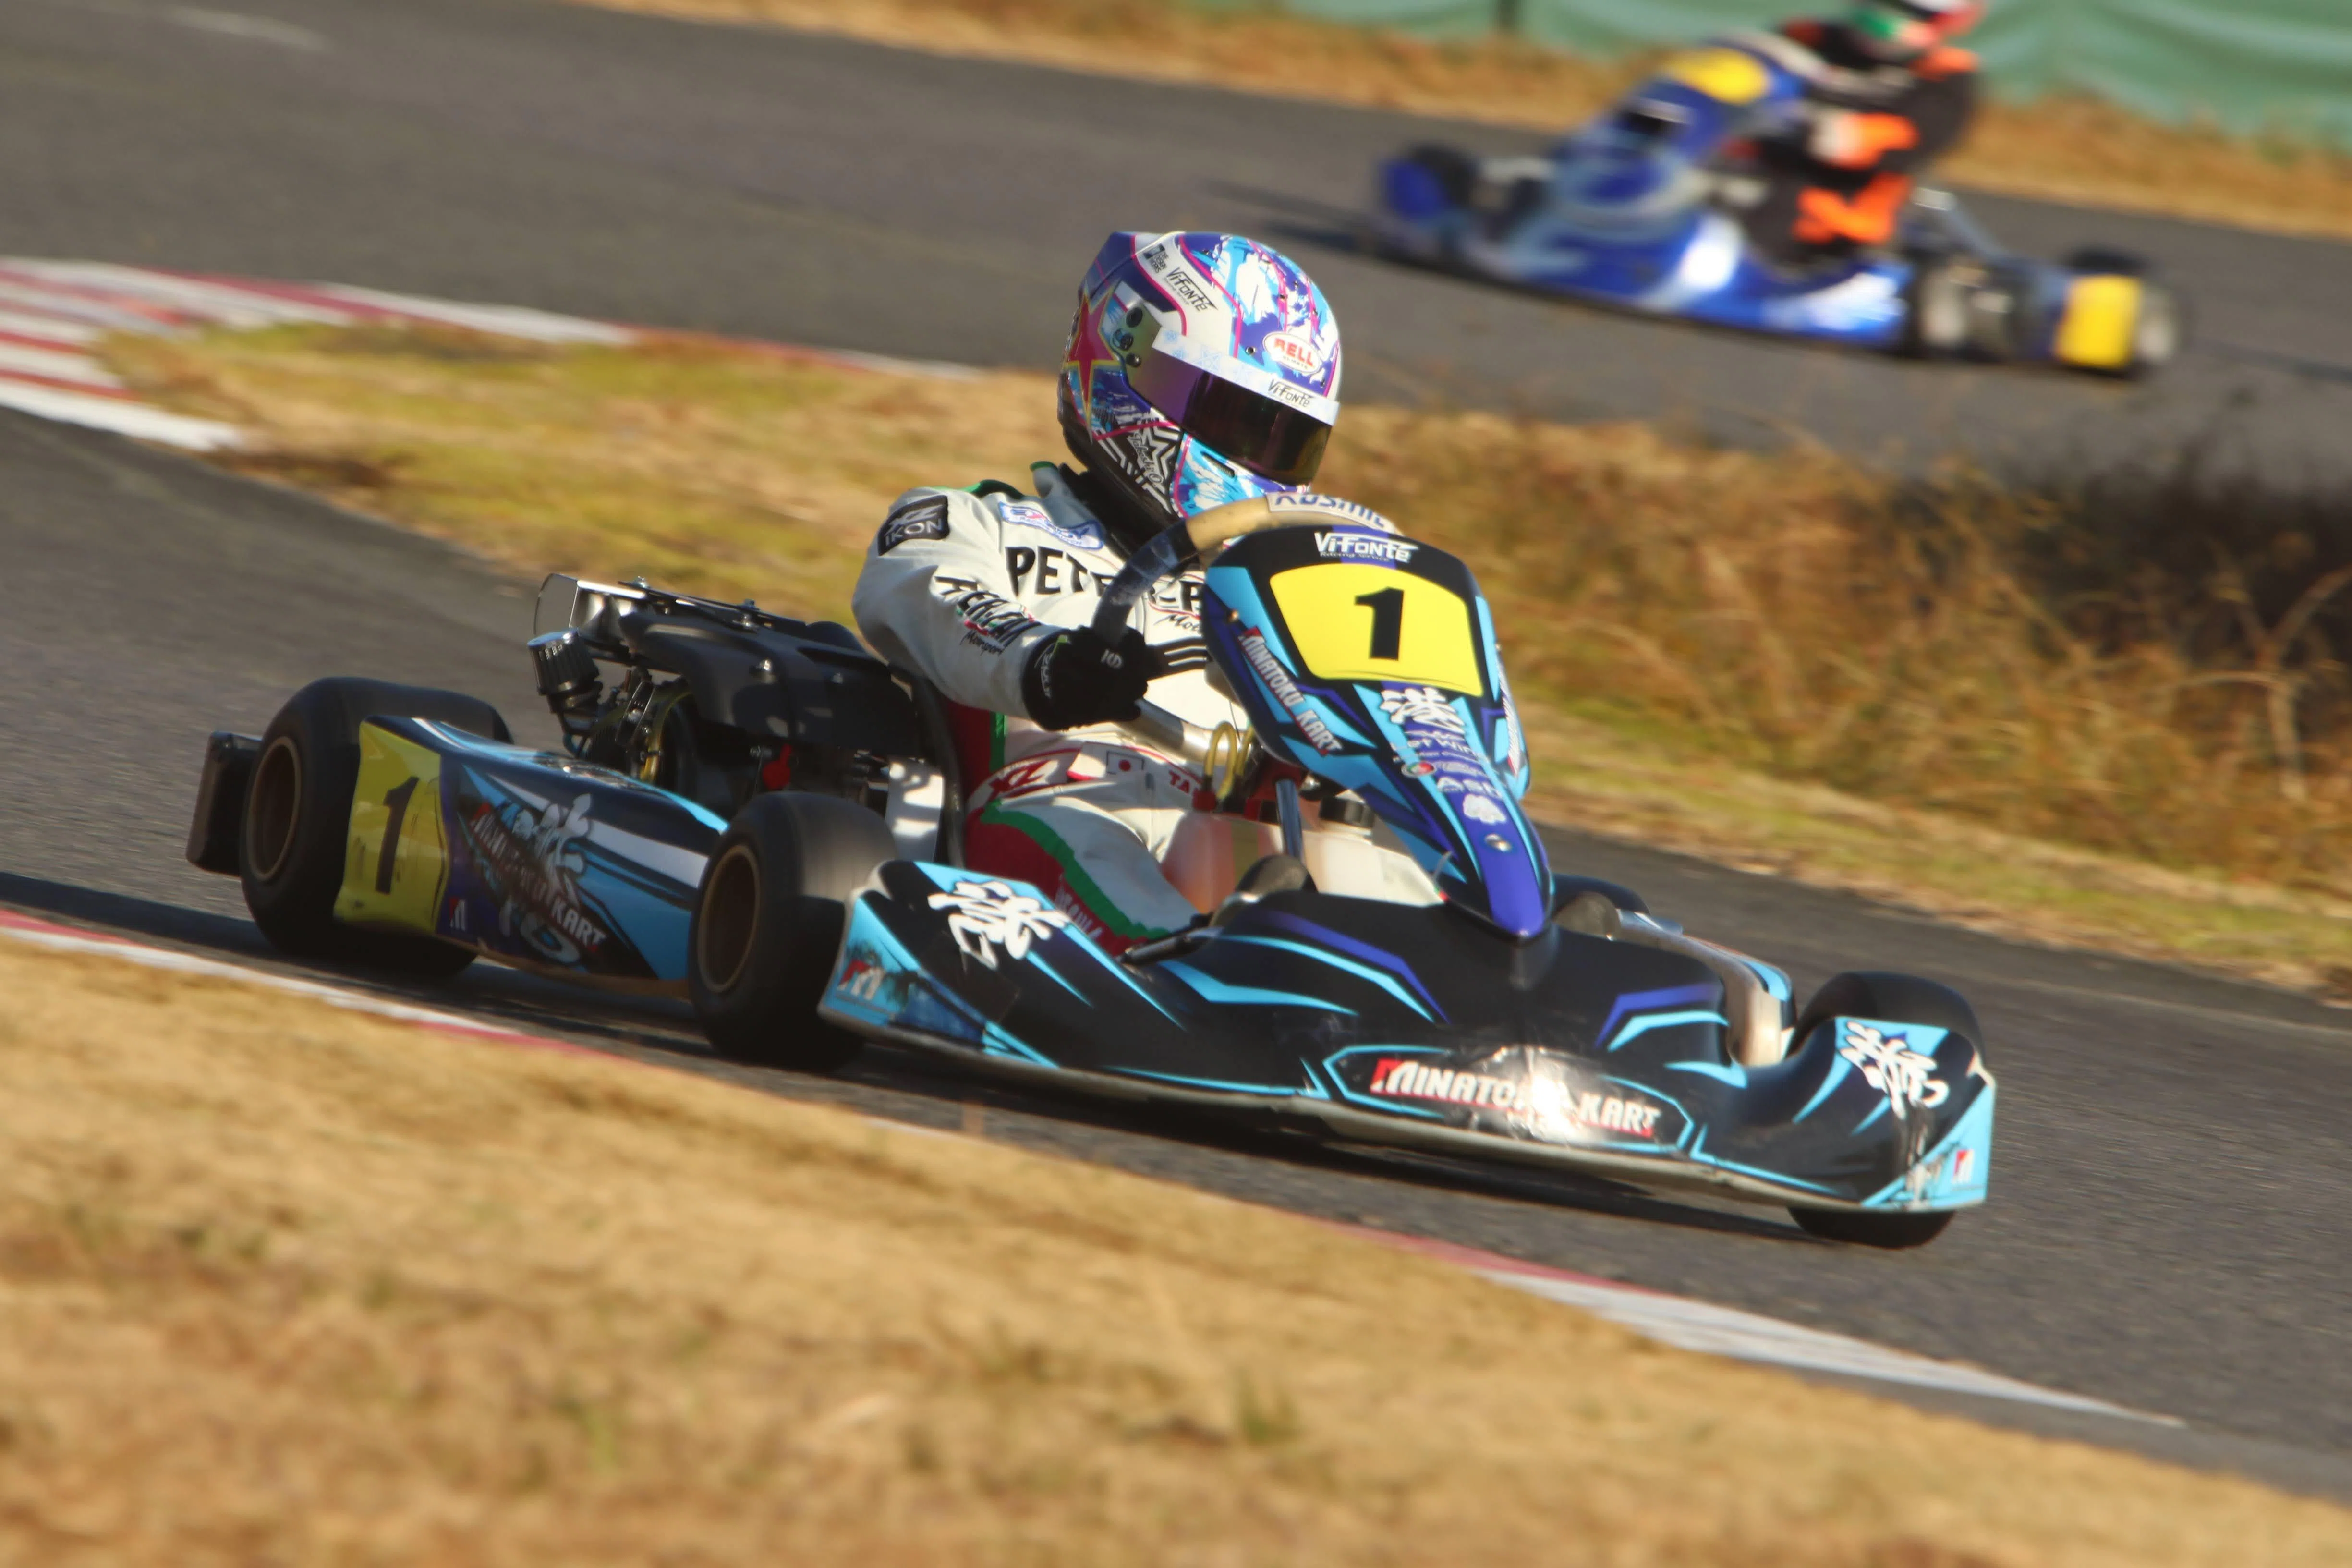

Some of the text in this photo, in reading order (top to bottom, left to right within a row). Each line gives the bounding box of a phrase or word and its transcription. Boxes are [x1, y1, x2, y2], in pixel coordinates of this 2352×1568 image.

[885, 518, 942, 546] IKON
[1354, 586, 1404, 661] 1
[1237, 627, 1343, 752] MINATOKU KART
[375, 776, 420, 894] 1
[551, 897, 607, 947] KART
[1579, 1091, 1661, 1132] KART
